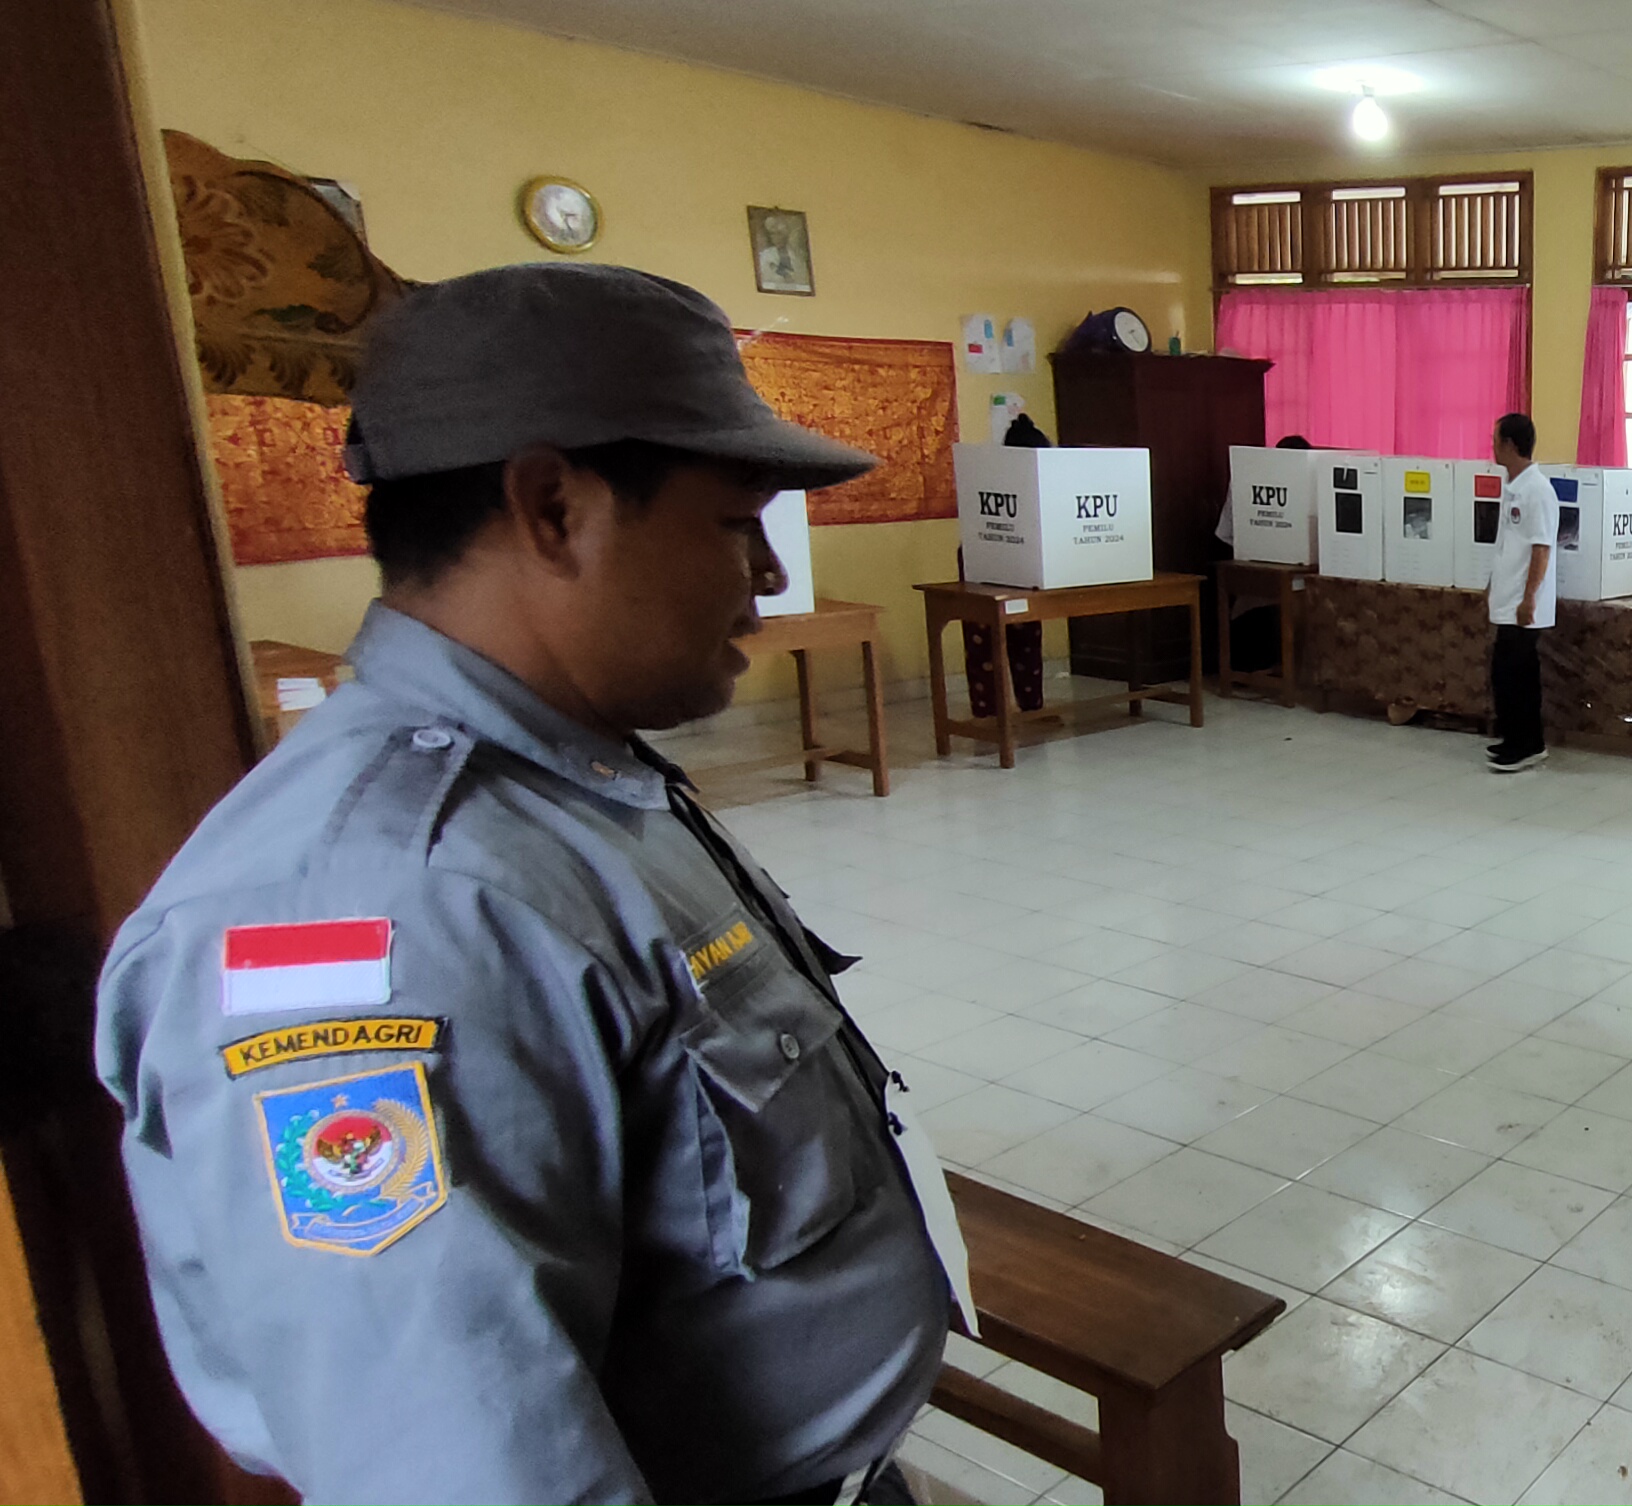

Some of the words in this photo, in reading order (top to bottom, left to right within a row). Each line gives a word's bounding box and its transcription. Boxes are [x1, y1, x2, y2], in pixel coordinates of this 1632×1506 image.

[1252, 485, 1288, 507] KPU
[978, 491, 1017, 518] KPU
[1076, 494, 1118, 518] KPU
[1257, 510, 1284, 519] PEMILU
[986, 521, 1015, 532] PEMILU
[1083, 524, 1115, 533] PEMILU
[978, 531, 1003, 542] TAHUN
[1005, 535, 1025, 544] 2024
[1073, 535, 1101, 545] TAHUN
[1105, 534, 1125, 544] 2024
[240, 1024, 423, 1067] KEMENDAGRI
